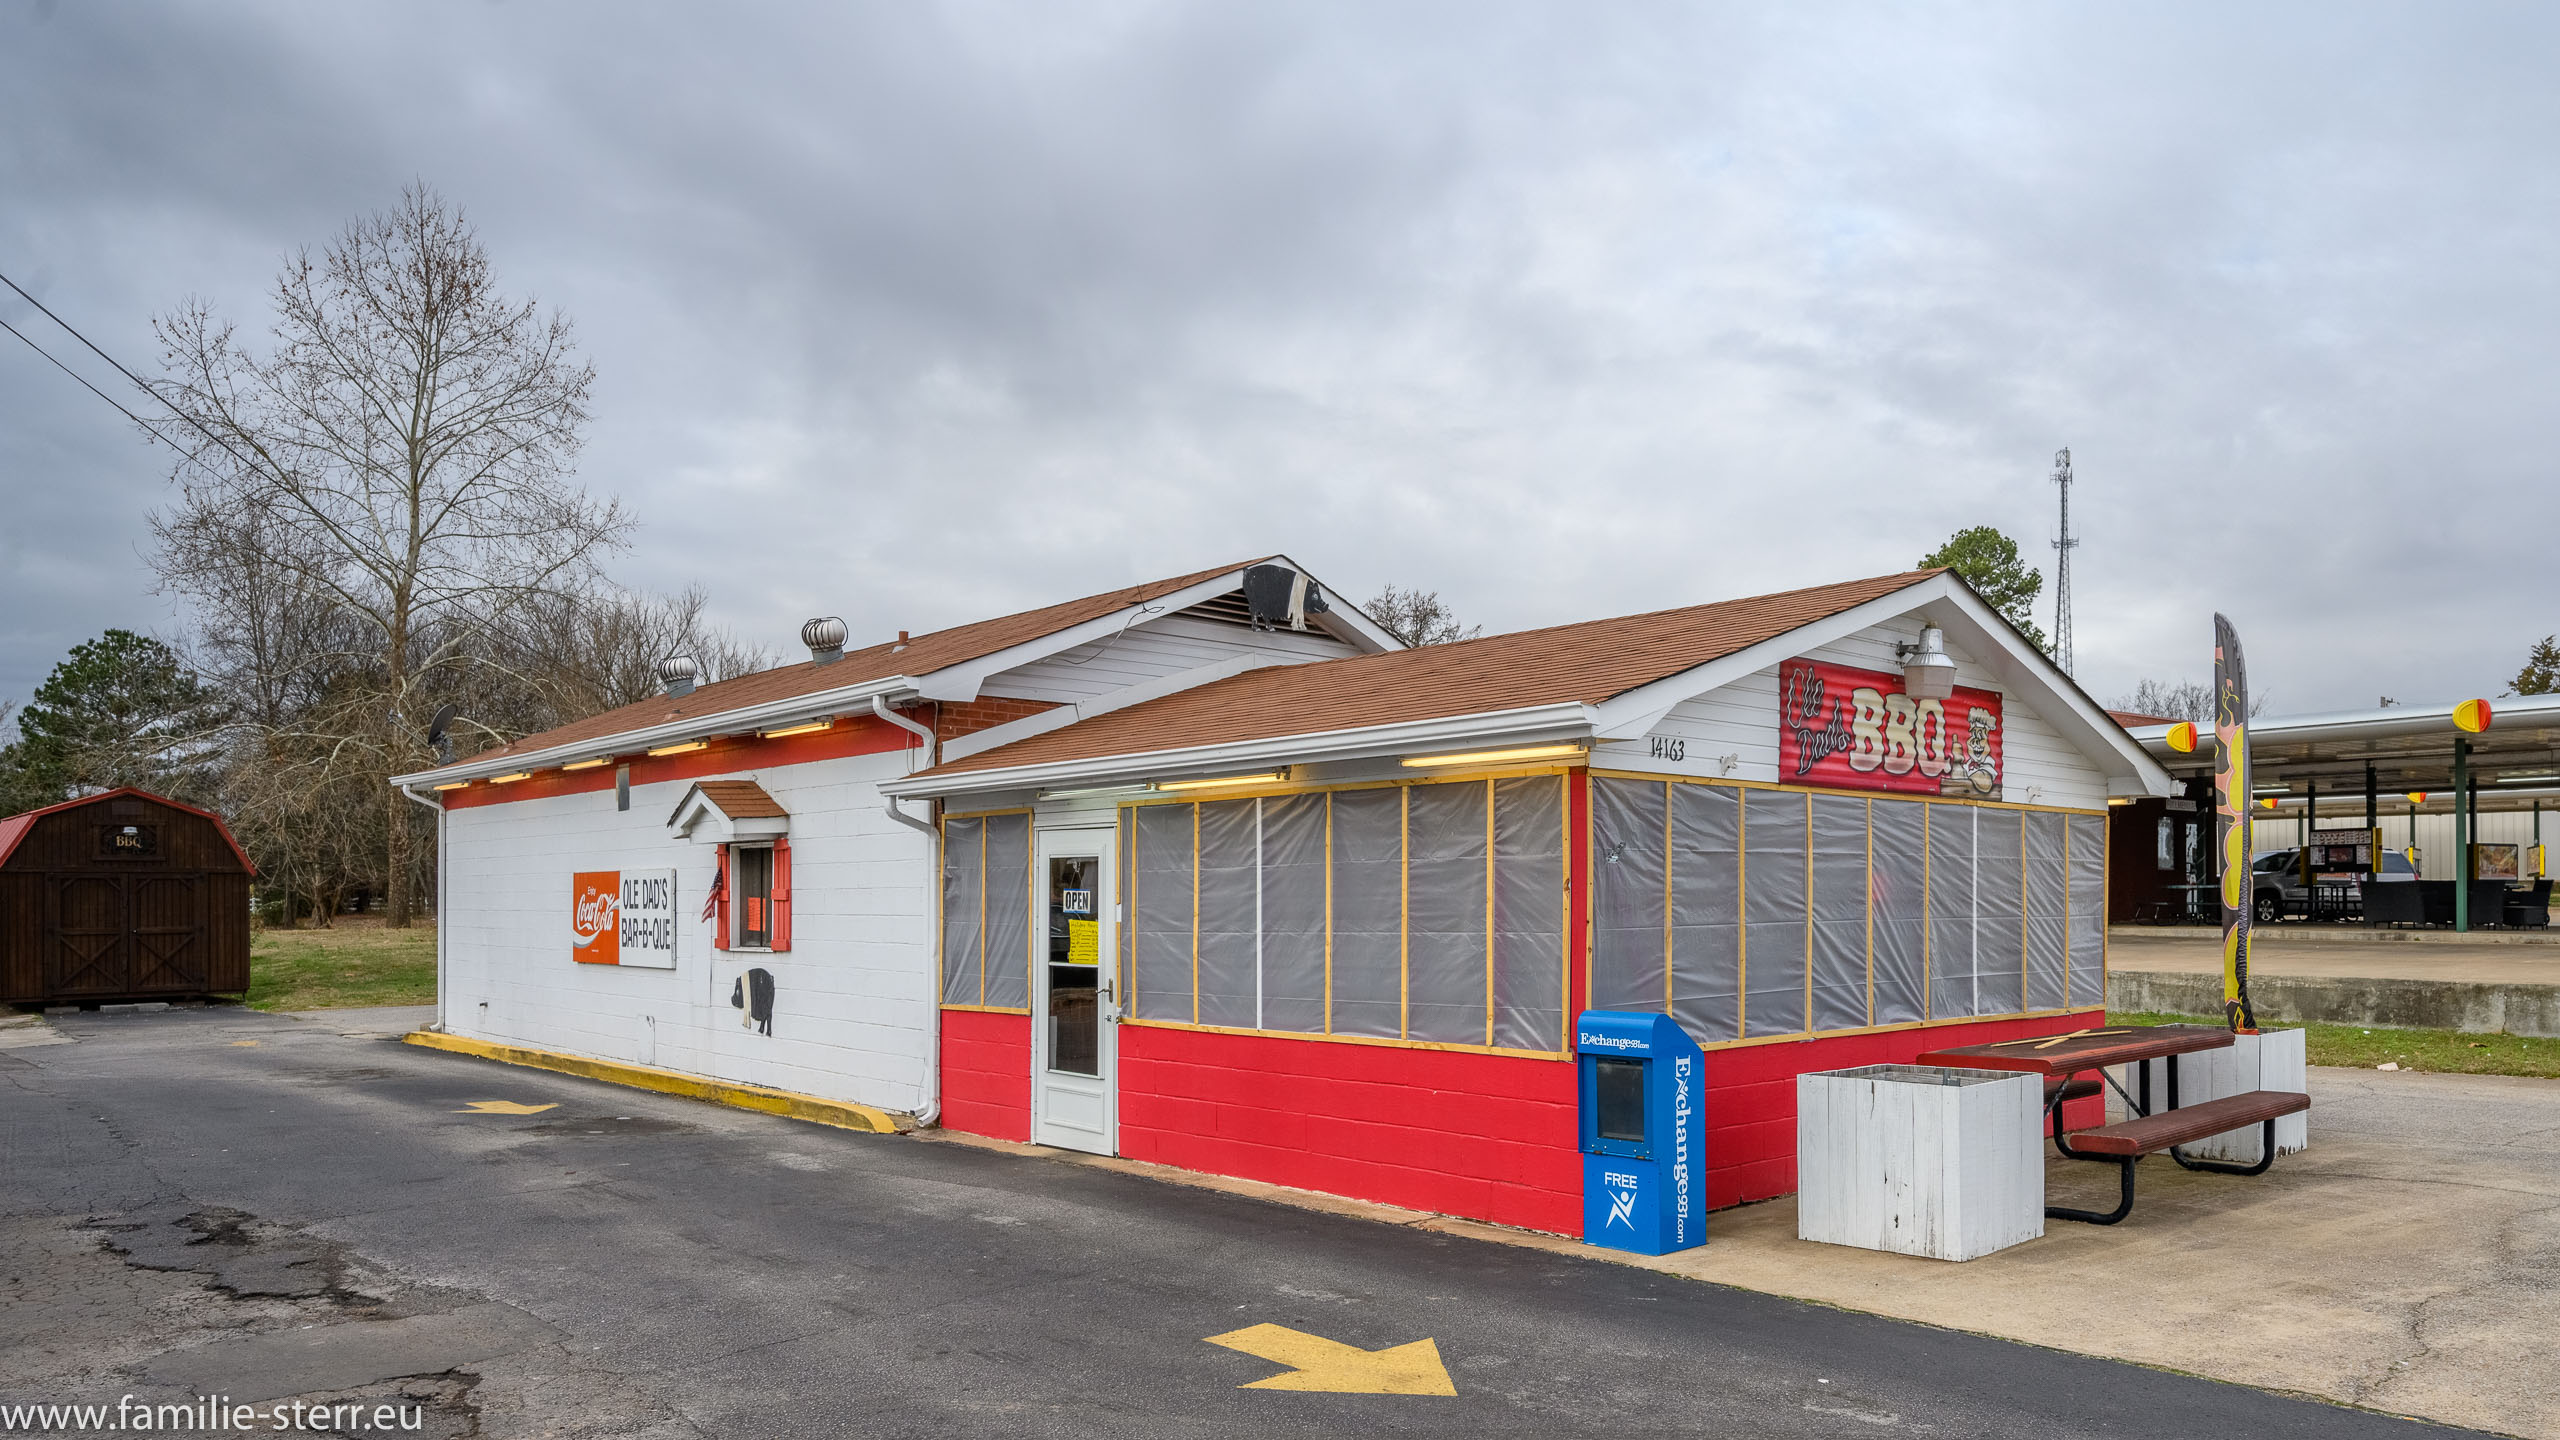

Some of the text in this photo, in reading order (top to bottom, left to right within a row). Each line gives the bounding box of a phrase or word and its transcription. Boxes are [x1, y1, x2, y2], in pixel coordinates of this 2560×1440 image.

[1787, 667, 1825, 729] Ole
[1849, 687, 1952, 777] BBQ
[1650, 736, 1685, 761] 14163
[116, 835, 142, 848] BBQ
[588, 886, 596, 896] Enjoy
[623, 878, 668, 910] OLE DAD'S
[1065, 892, 1089, 910] OPEN
[621, 917, 671, 950] BAR-B-QUE
[1604, 1172, 1638, 1190] FREE
